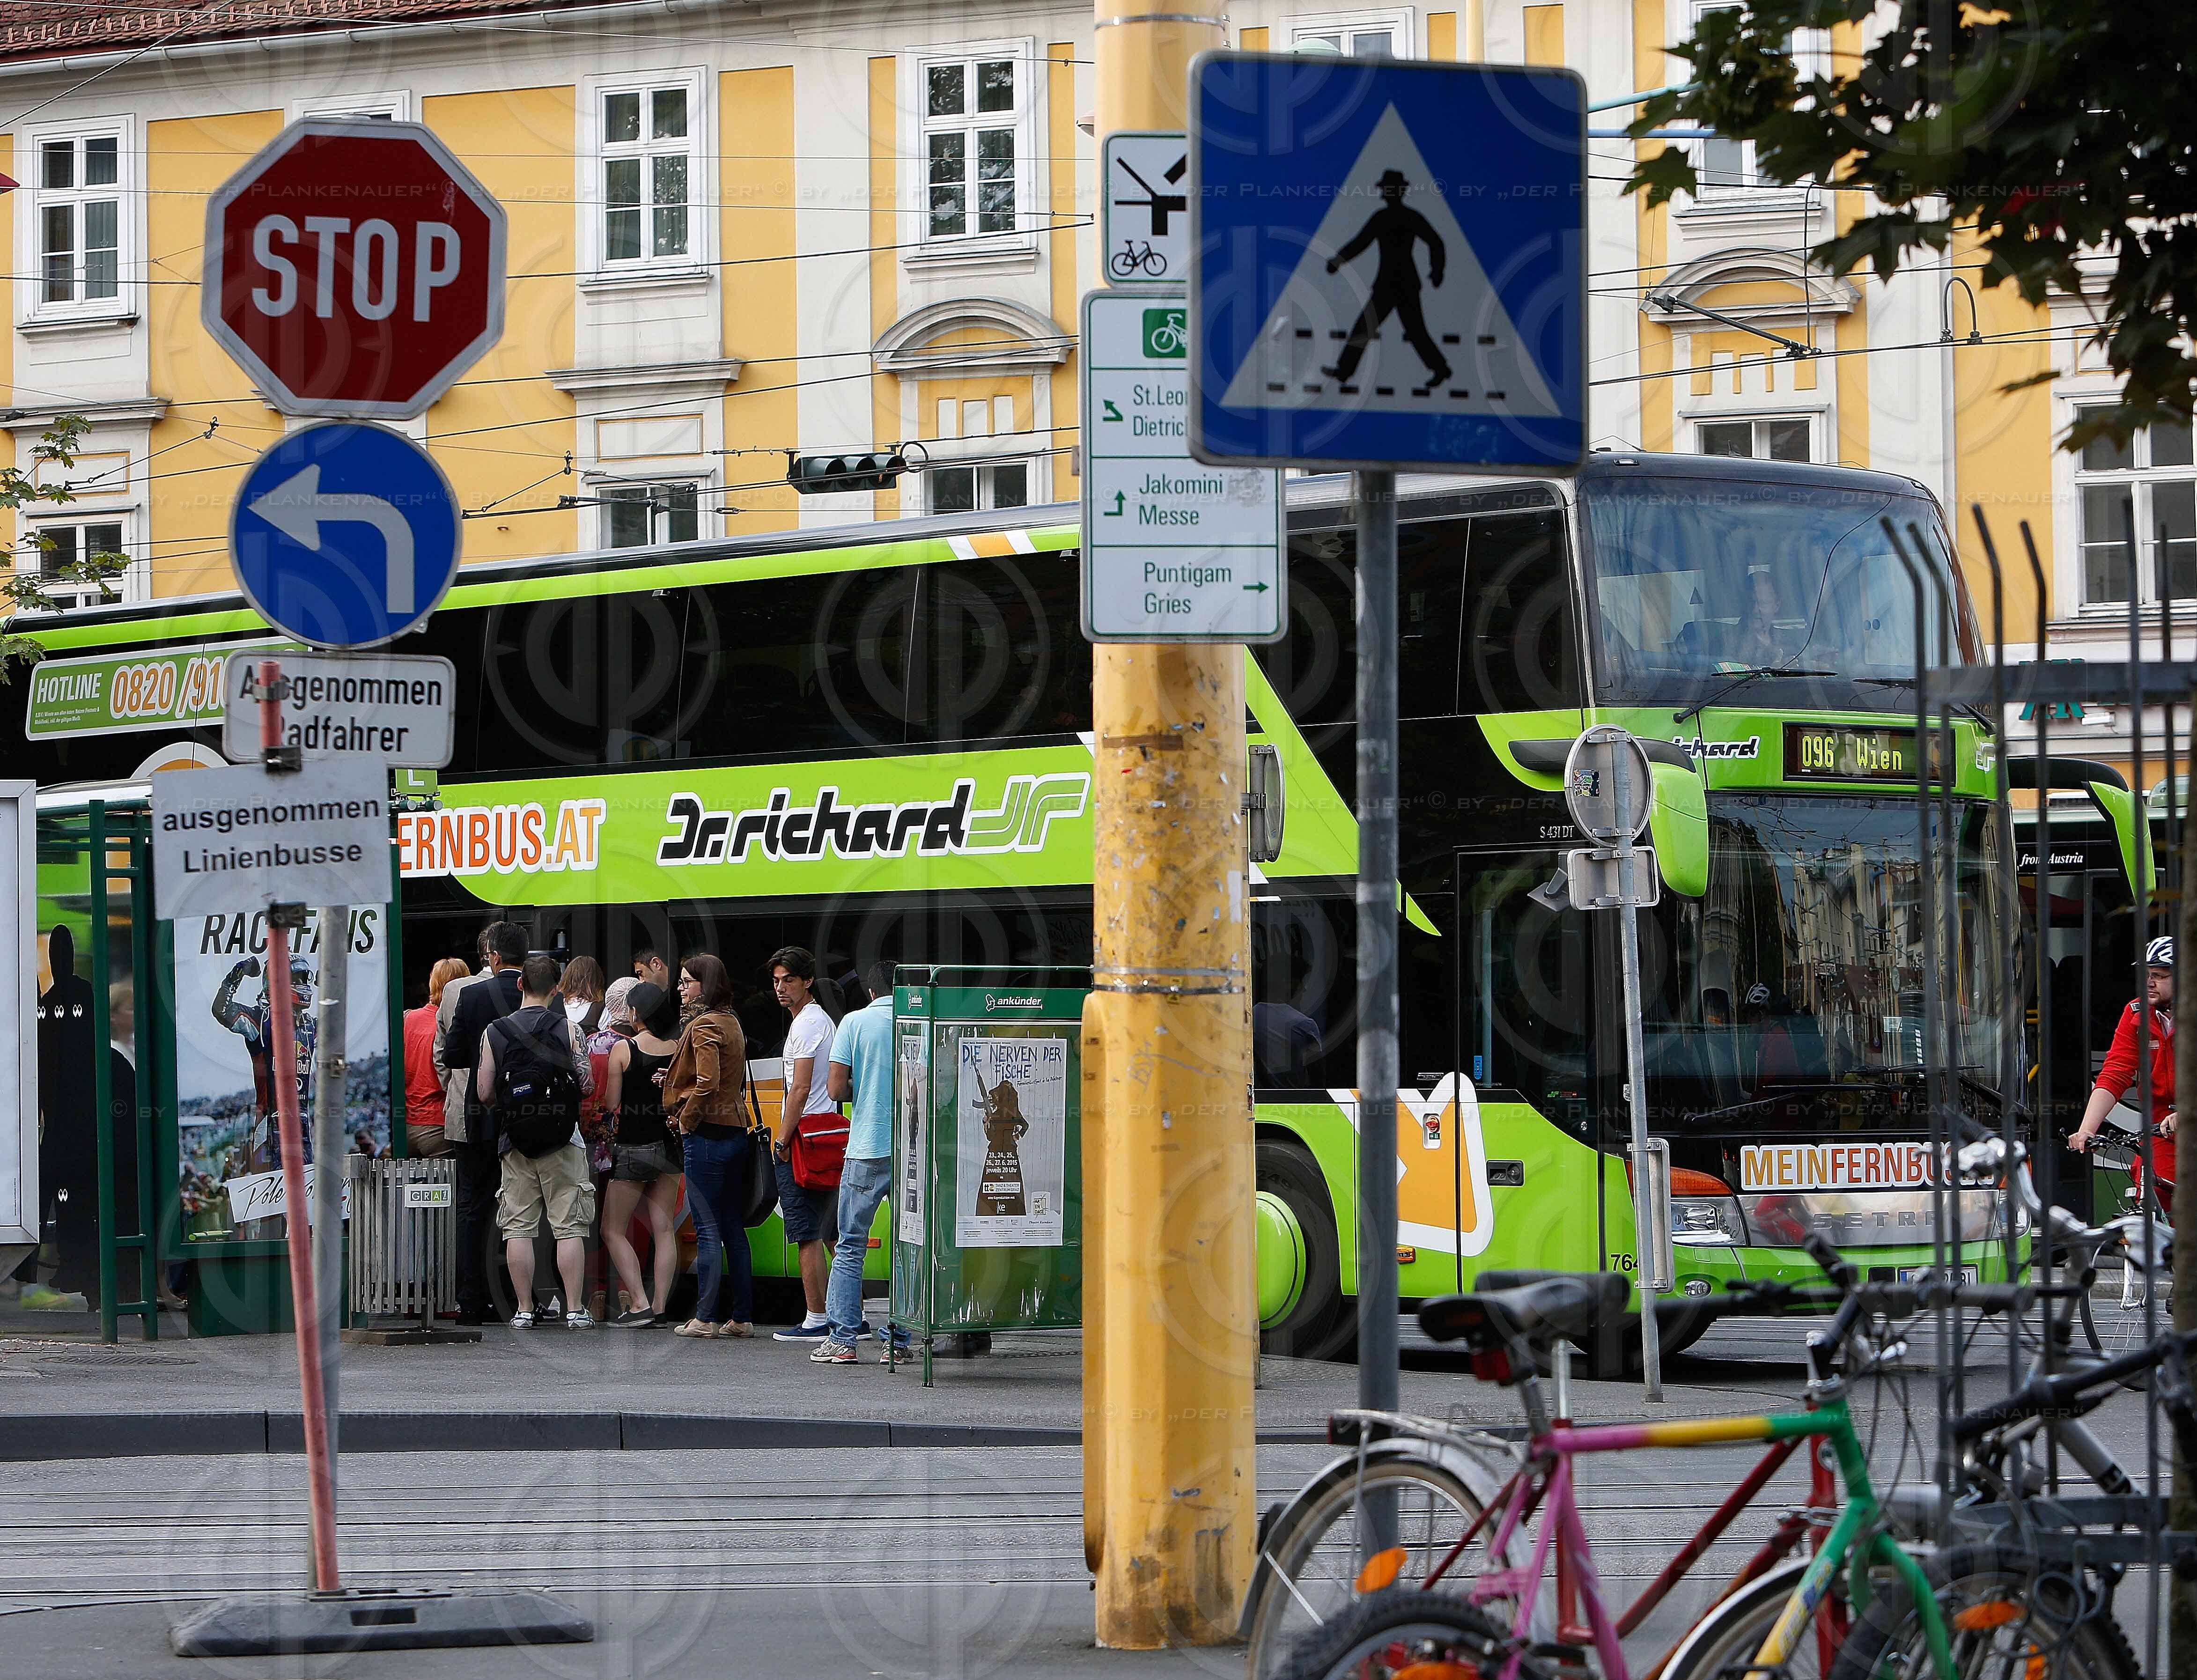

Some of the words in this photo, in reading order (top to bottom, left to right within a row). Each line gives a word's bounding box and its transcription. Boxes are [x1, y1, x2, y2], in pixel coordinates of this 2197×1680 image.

[252, 214, 461, 323] STOP
[1134, 385, 1187, 405] St.Leo
[1139, 474, 1223, 495] Jakomini
[1139, 505, 1199, 525] Messe
[1144, 562, 1231, 587] Puntigam
[1144, 593, 1191, 614] Gries
[37, 672, 102, 703] HOTLINE
[113, 666, 173, 715] 0820
[178, 661, 227, 713] /91
[239, 664, 442, 710] Agenommen
[280, 715, 409, 752] adfahrer
[1675, 738, 1758, 756] chard
[1802, 735, 1834, 767] 096
[1856, 737, 1902, 770] Wien
[162, 797, 381, 833] ausgenommen
[397, 807, 602, 870] ERNBUS.AT
[183, 842, 362, 874] Linienbusse
[2048, 852, 2083, 864] Austria
[997, 996, 1042, 1006] ankünder
[963, 1044, 982, 1064] DIE
[989, 1045, 1038, 1063] NERVEN
[1043, 1046, 1062, 1063] DER
[1745, 1146, 1994, 1186] MEINFERNBU
[411, 1190, 449, 1201] GRAZ
